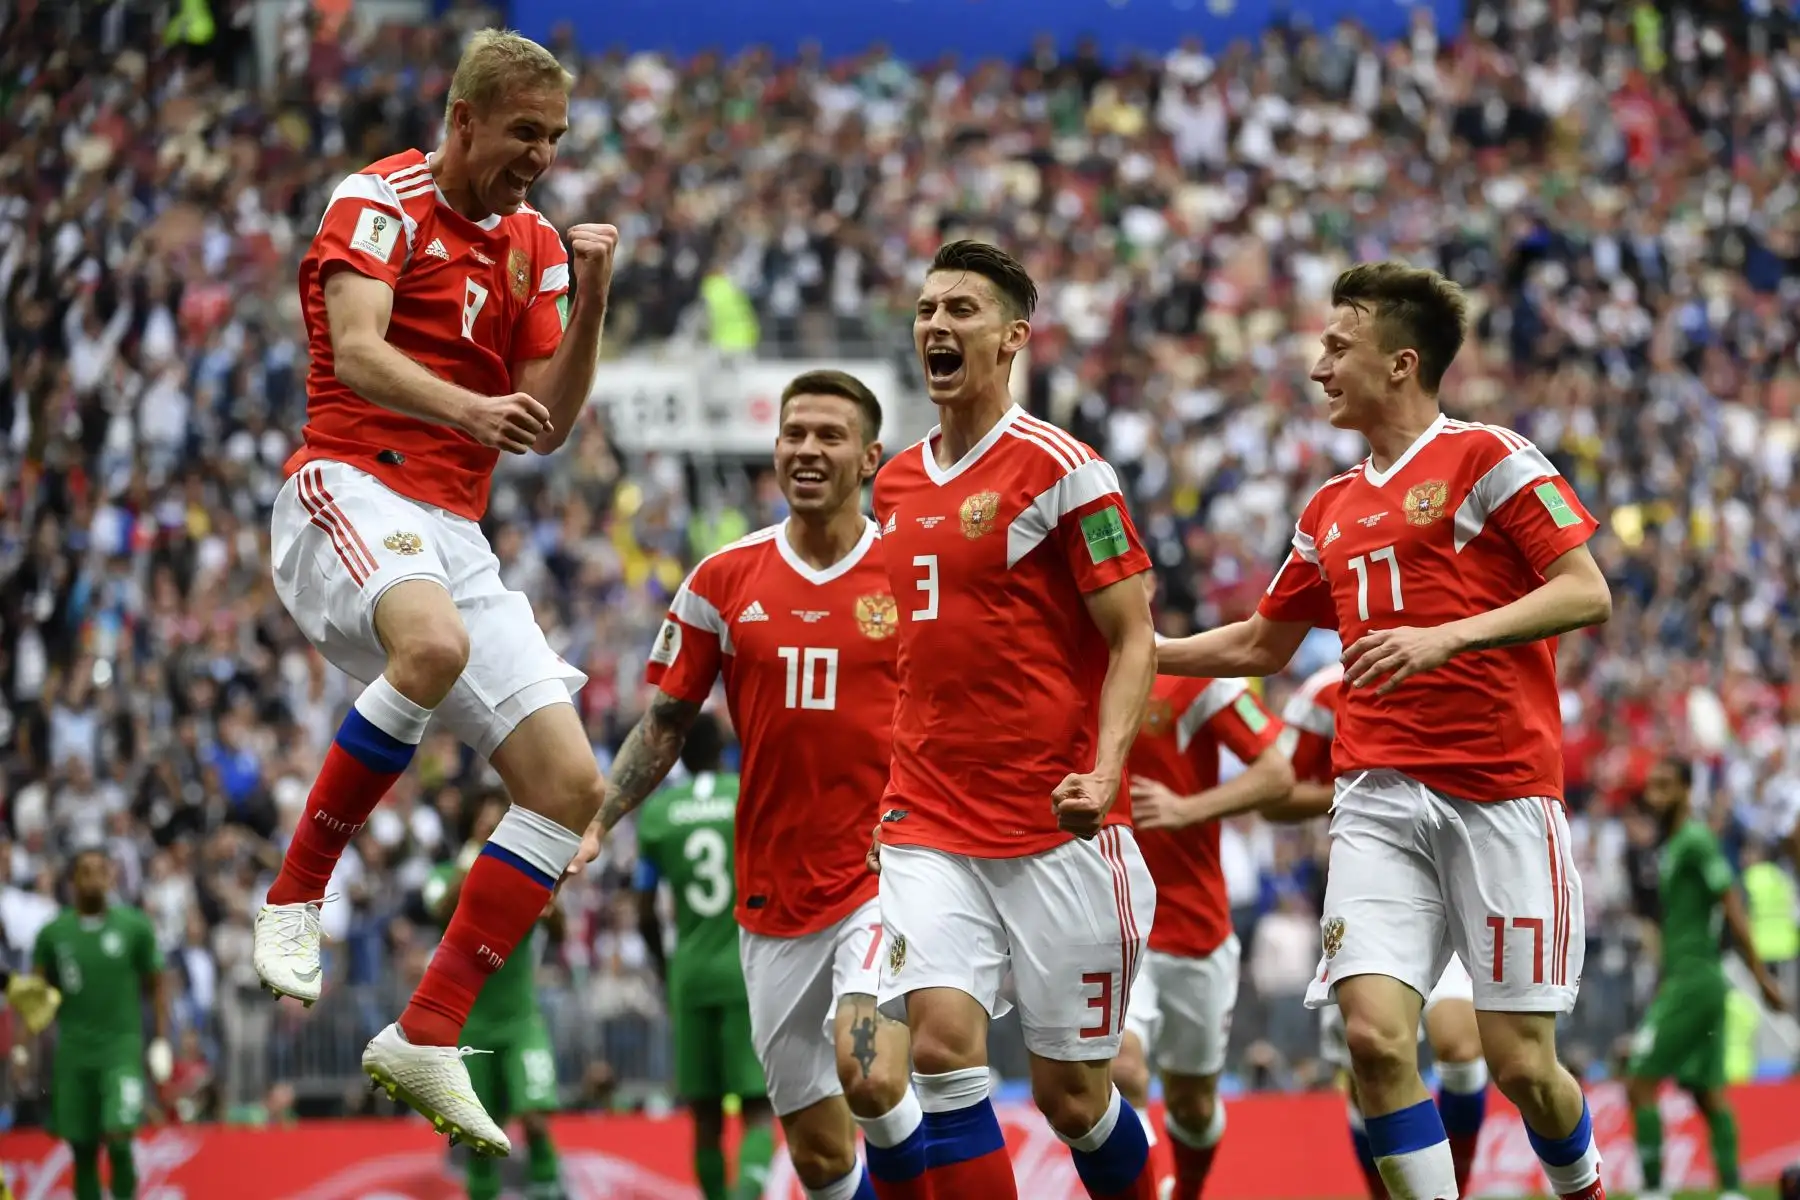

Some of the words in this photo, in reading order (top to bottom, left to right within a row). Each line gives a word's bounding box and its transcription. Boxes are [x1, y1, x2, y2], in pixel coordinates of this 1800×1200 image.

[424, 247, 450, 261] adidas
[911, 554, 940, 621] 3
[1347, 545, 1404, 621] 17
[739, 613, 769, 623] adidas
[777, 646, 839, 711] 10
[684, 827, 732, 917] 3
[1486, 916, 1544, 984] 17
[1079, 972, 1112, 1038] 3
